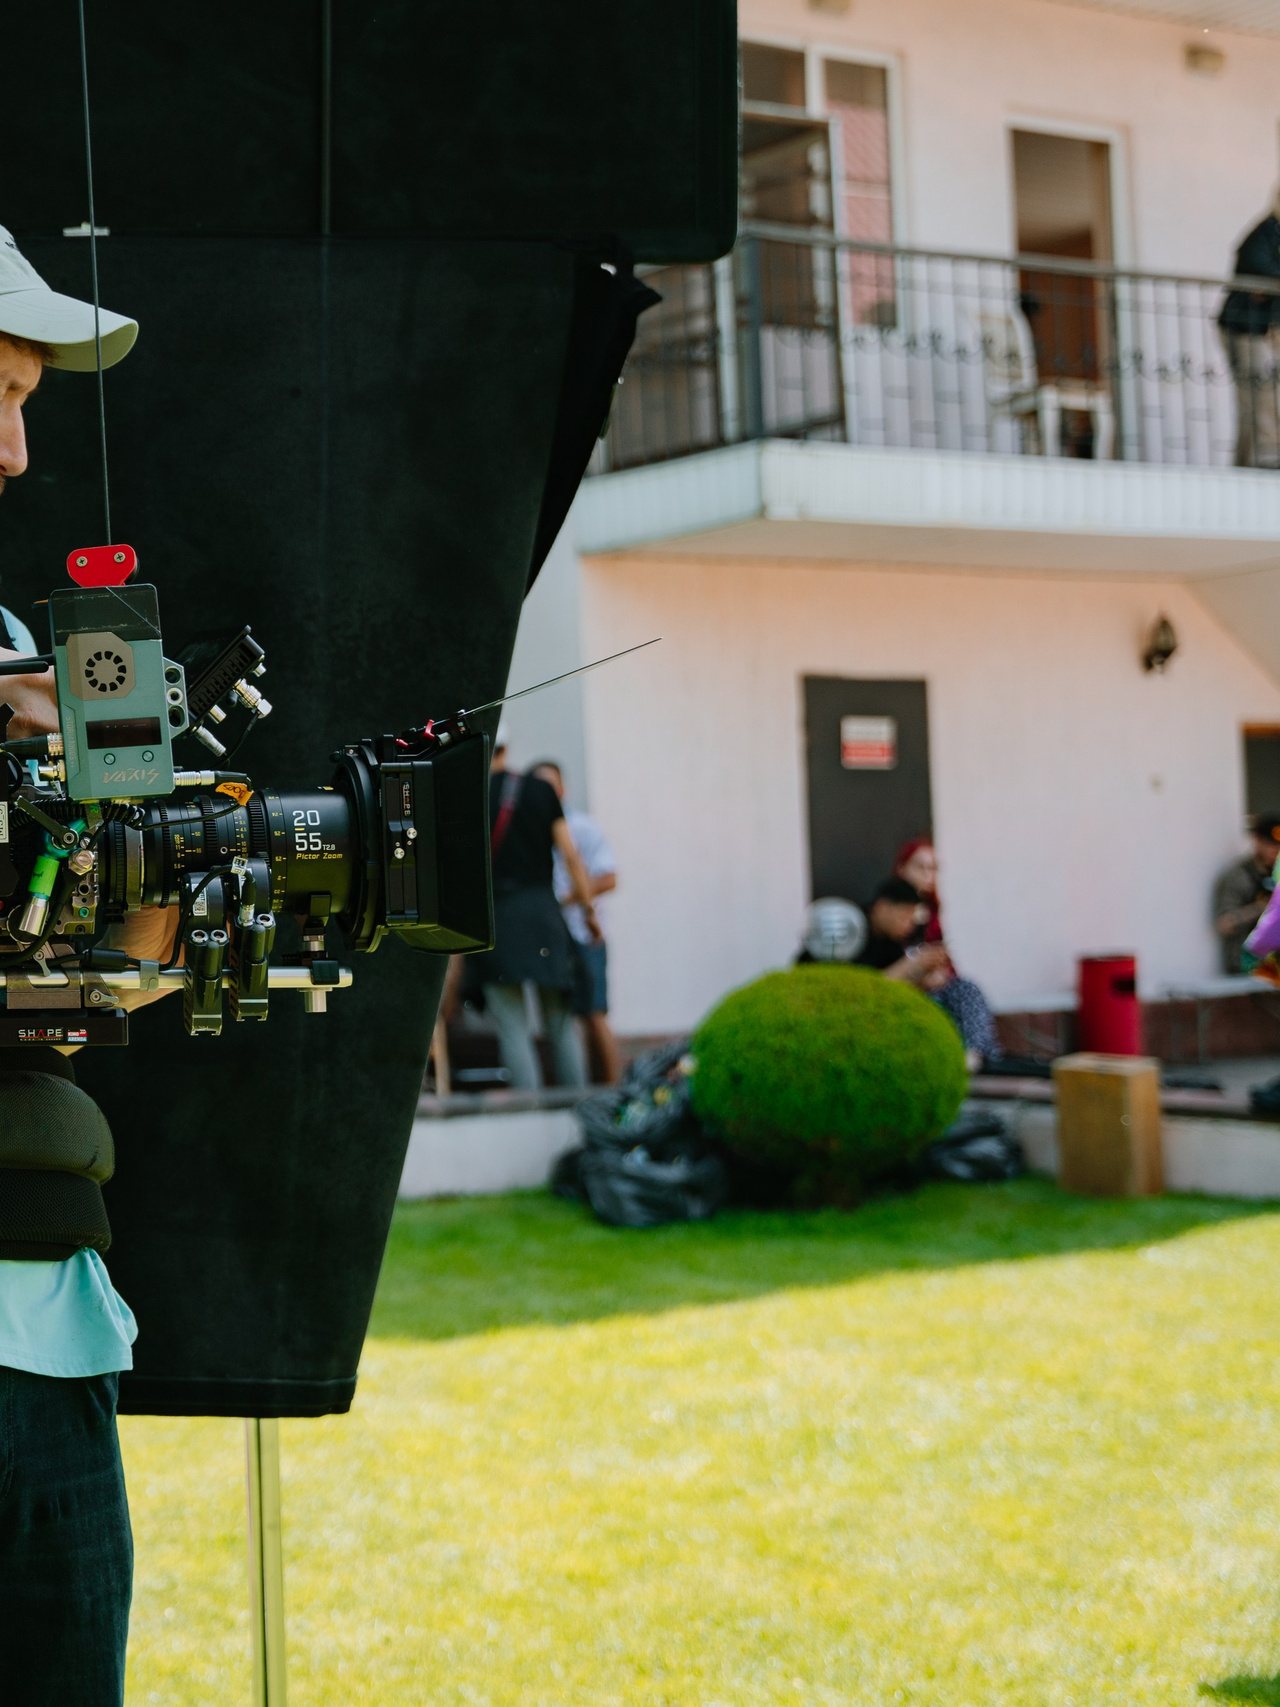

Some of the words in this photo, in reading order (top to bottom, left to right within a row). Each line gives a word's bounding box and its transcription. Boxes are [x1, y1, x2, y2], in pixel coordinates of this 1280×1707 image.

[102, 768, 160, 786] VAXIS
[292, 810, 321, 826] 20
[294, 832, 322, 851] 55
[295, 852, 320, 860] Pictor
[18, 1028, 63, 1038] SHAPE
